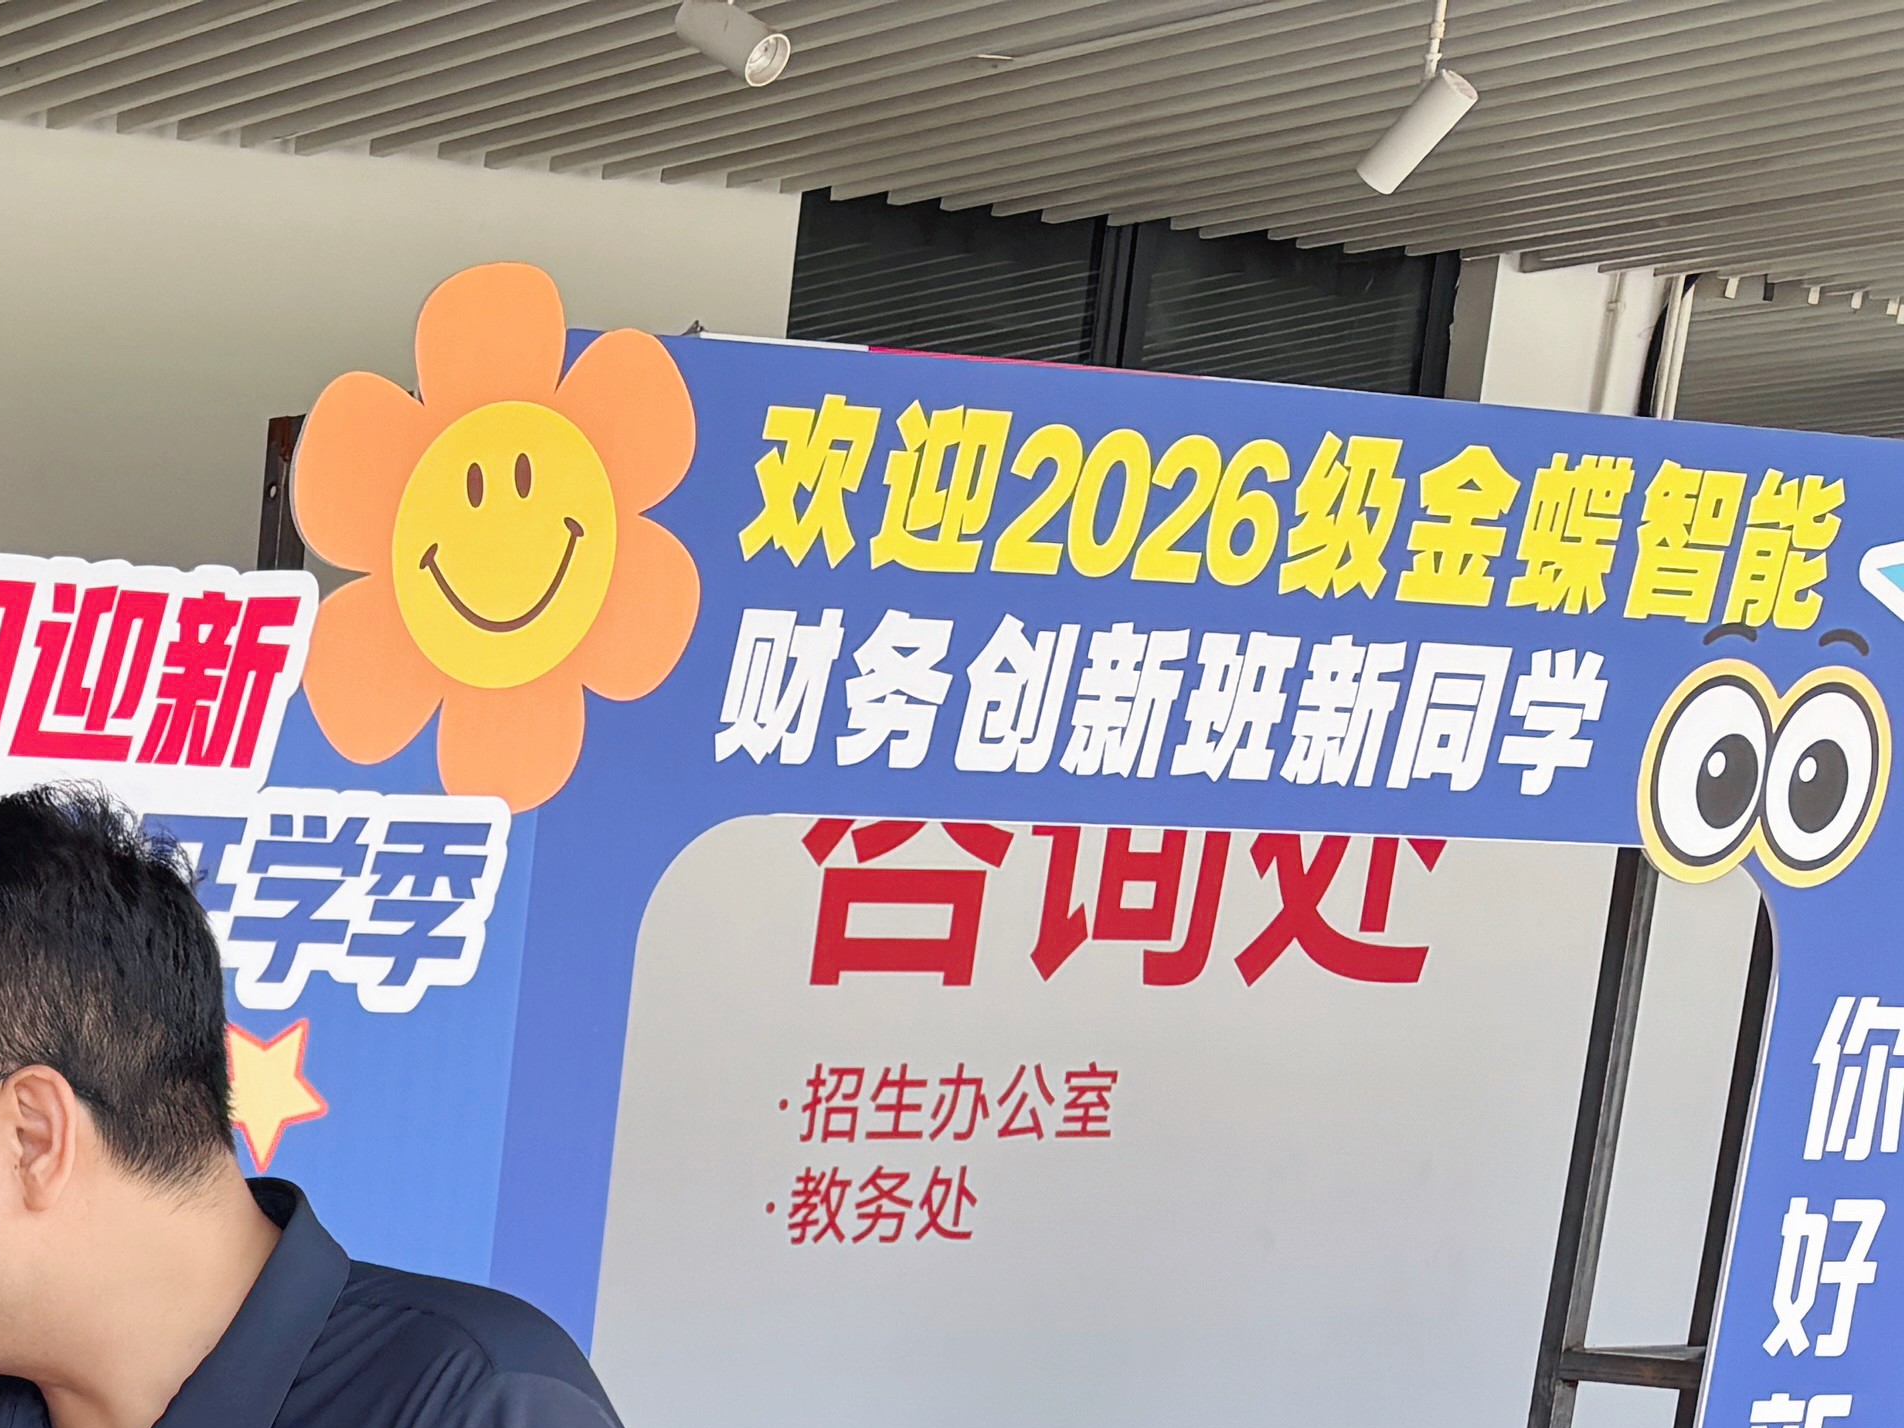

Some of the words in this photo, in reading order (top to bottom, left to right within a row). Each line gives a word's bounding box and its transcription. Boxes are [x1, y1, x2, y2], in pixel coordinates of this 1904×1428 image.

[738, 394, 1848, 631] 欢迎2026级金蝶智能
[715, 608, 1609, 797] 财务创新班新同学
